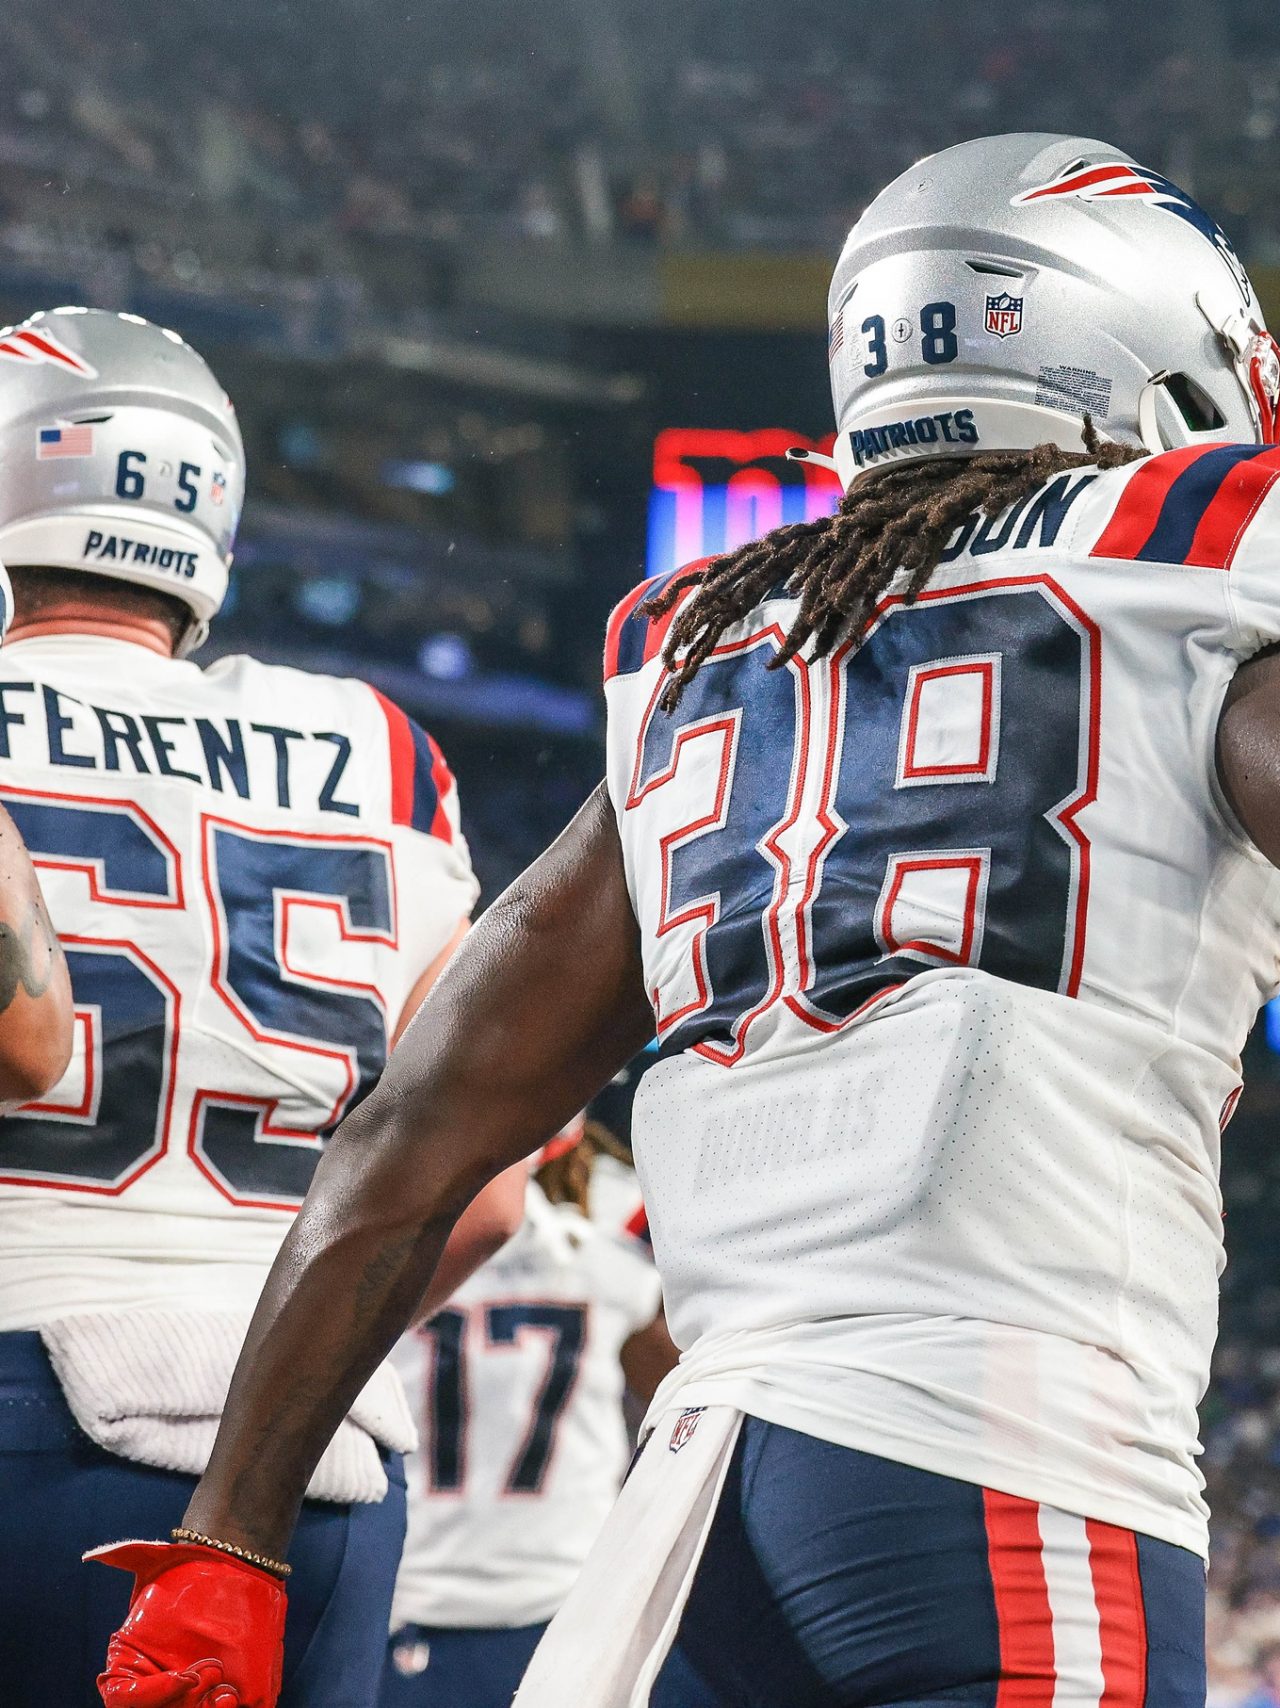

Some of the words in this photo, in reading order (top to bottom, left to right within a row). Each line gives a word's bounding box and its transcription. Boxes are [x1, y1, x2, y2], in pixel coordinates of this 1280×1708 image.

[988, 311, 1019, 334] NFL
[1059, 364, 1097, 376] WARNING
[849, 409, 979, 466] PATRIOTS
[84, 530, 198, 579] PATRIOTS
[0, 682, 360, 817] FERENTZ
[626, 574, 1100, 1067] 38
[0, 785, 398, 1212] 65
[416, 1300, 589, 1494] 17
